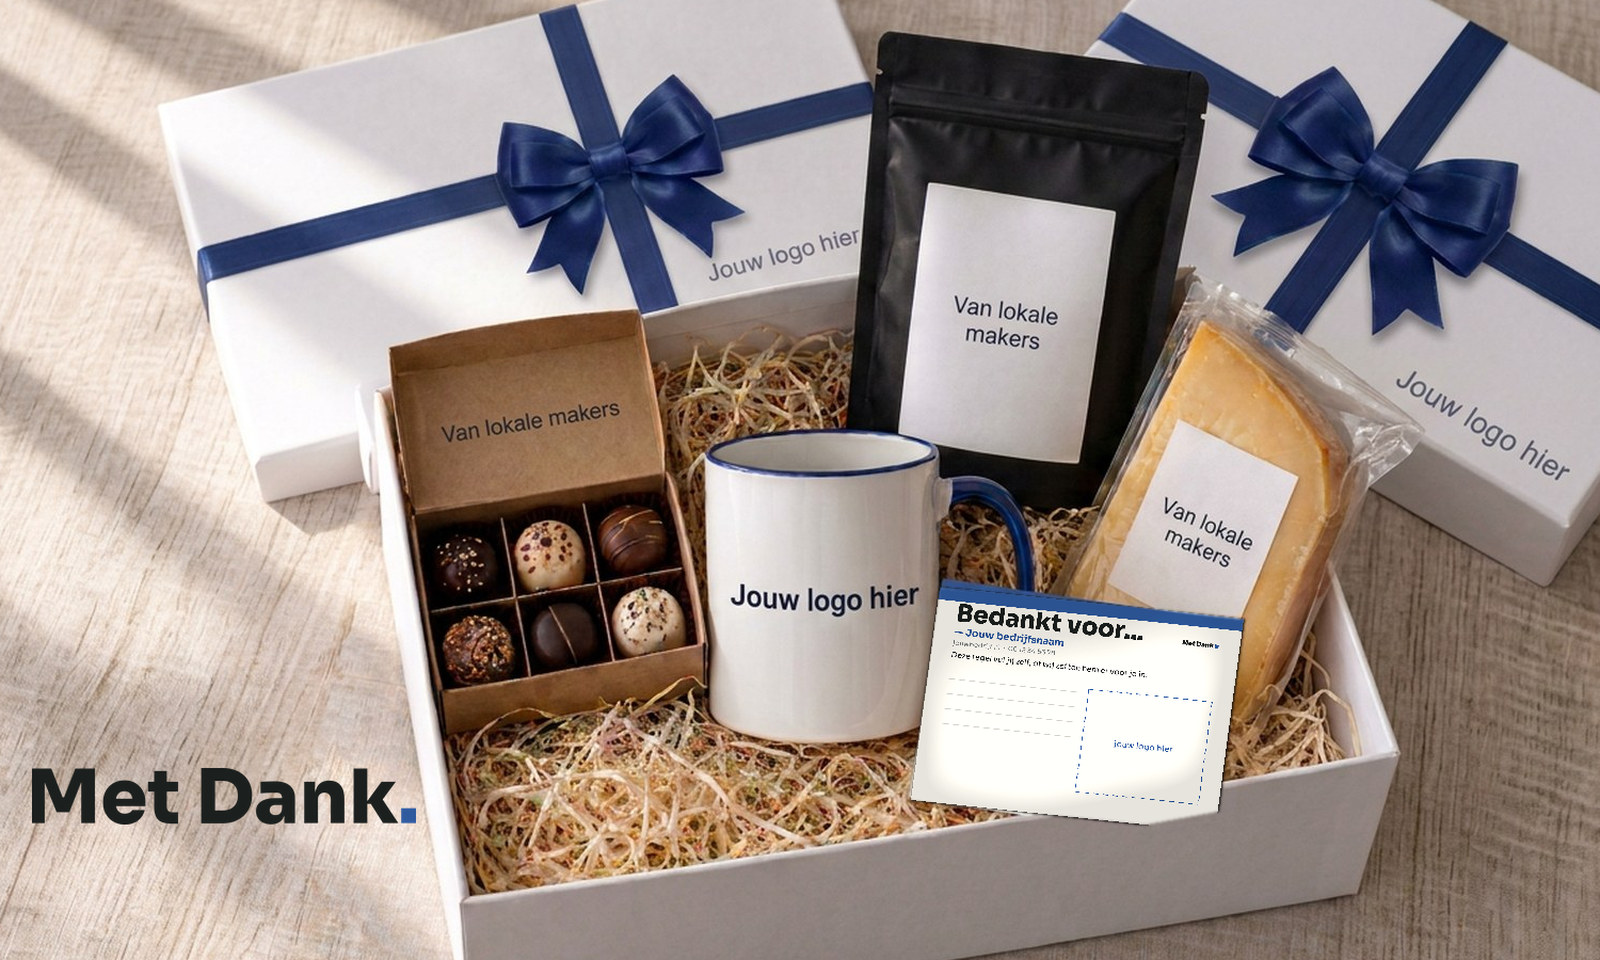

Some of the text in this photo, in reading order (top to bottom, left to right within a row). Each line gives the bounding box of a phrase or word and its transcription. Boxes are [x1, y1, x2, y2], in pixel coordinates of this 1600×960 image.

[709, 229, 860, 282] Jouw logo hier
[954, 295, 1058, 326] Van lokale
[965, 327, 1040, 350] makers
[441, 402, 620, 443] Van lokale makers
[1396, 371, 1570, 481] Jouw logo hier
[1163, 496, 1253, 551] Van lokale
[1164, 529, 1231, 568] makers
[730, 583, 919, 617] Jouw logo hier
[957, 603, 1061, 632] Bedankt
[965, 628, 995, 640] Jouw
[996, 631, 1065, 648] bedrijfsnaam
